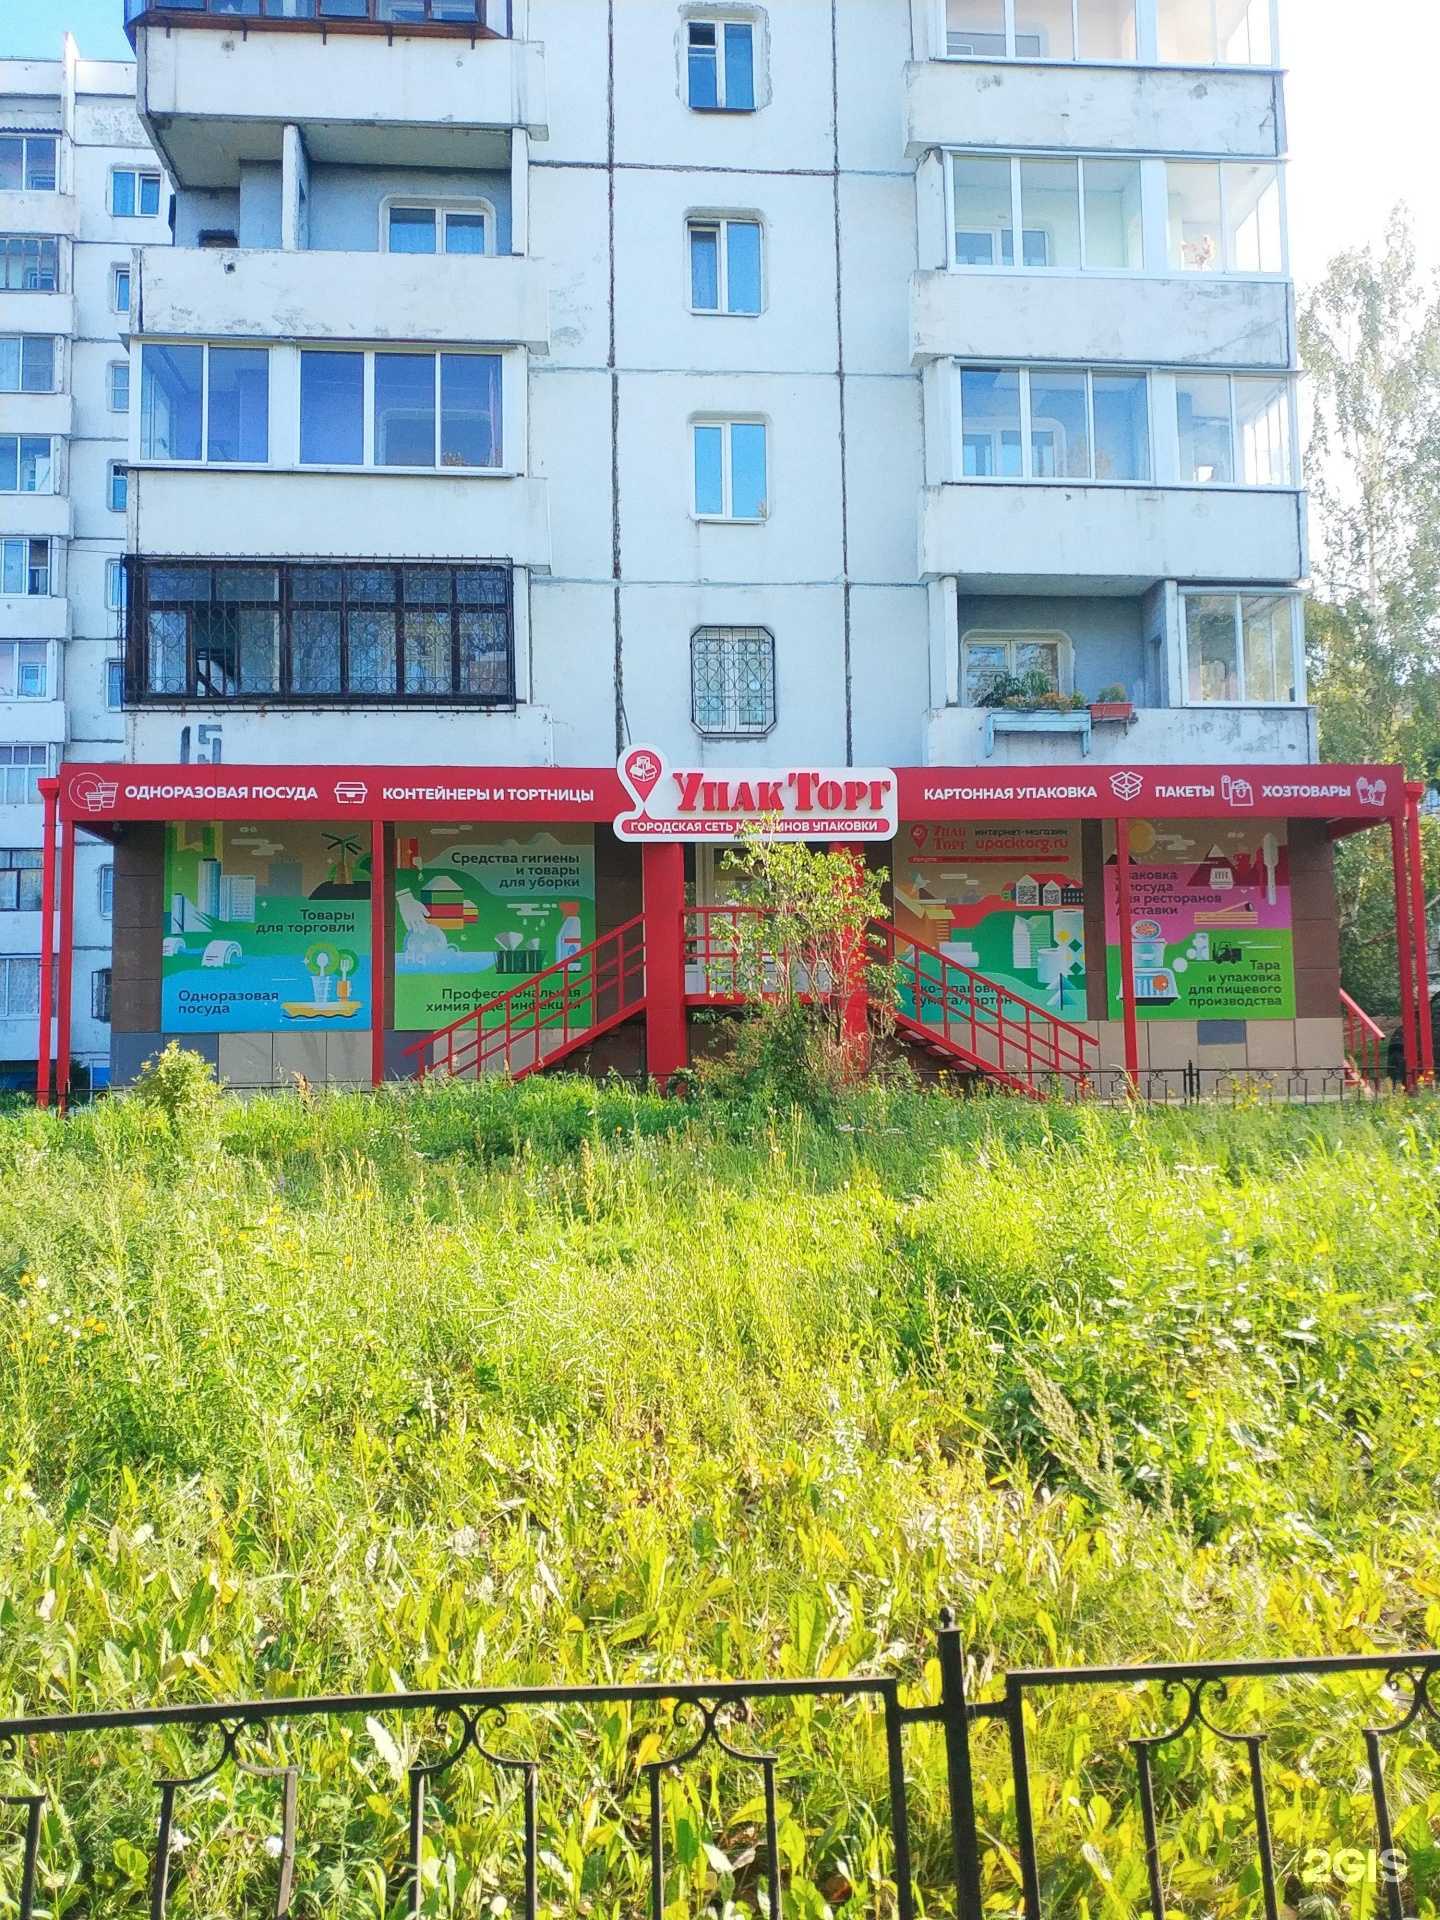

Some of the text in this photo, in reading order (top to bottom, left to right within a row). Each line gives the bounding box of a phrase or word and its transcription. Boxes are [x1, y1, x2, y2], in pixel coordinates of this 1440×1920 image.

[180, 724, 222, 764] 15
[125, 785, 318, 800] ОДНОРАЗОВАЯ ПОСУДА
[383, 786, 594, 803] КОНТЕЙНЕРЫ И ТОРТНИЦЫ
[924, 786, 1098, 800] КАРТОННАЯ УПАКОВКА
[1155, 785, 1214, 798] ПАКЕТЫ
[1262, 785, 1351, 798] ХОЗТОВАРЫ
[631, 821, 701, 833] ГОРОДСКАЯ
[704, 821, 733, 832] СЕТЬ
[812, 820, 878, 832] УПАКОВКИ
[451, 852, 580, 866] Средства гигиены
[516, 866, 580, 877] и товары
[499, 877, 580, 889] для уборки
[1144, 895, 1222, 906] ресторанов
[300, 908, 355, 922] Товары
[256, 924, 355, 935] для торговли
[1249, 960, 1281, 973] Тара
[1208, 973, 1281, 985] и упаковка
[178, 990, 279, 1003] Одноразовая
[1188, 985, 1282, 995] для пищевого
[426, 1003, 470, 1012] химия
[1188, 997, 1282, 1008] производства
[178, 1006, 230, 1017] посуда
